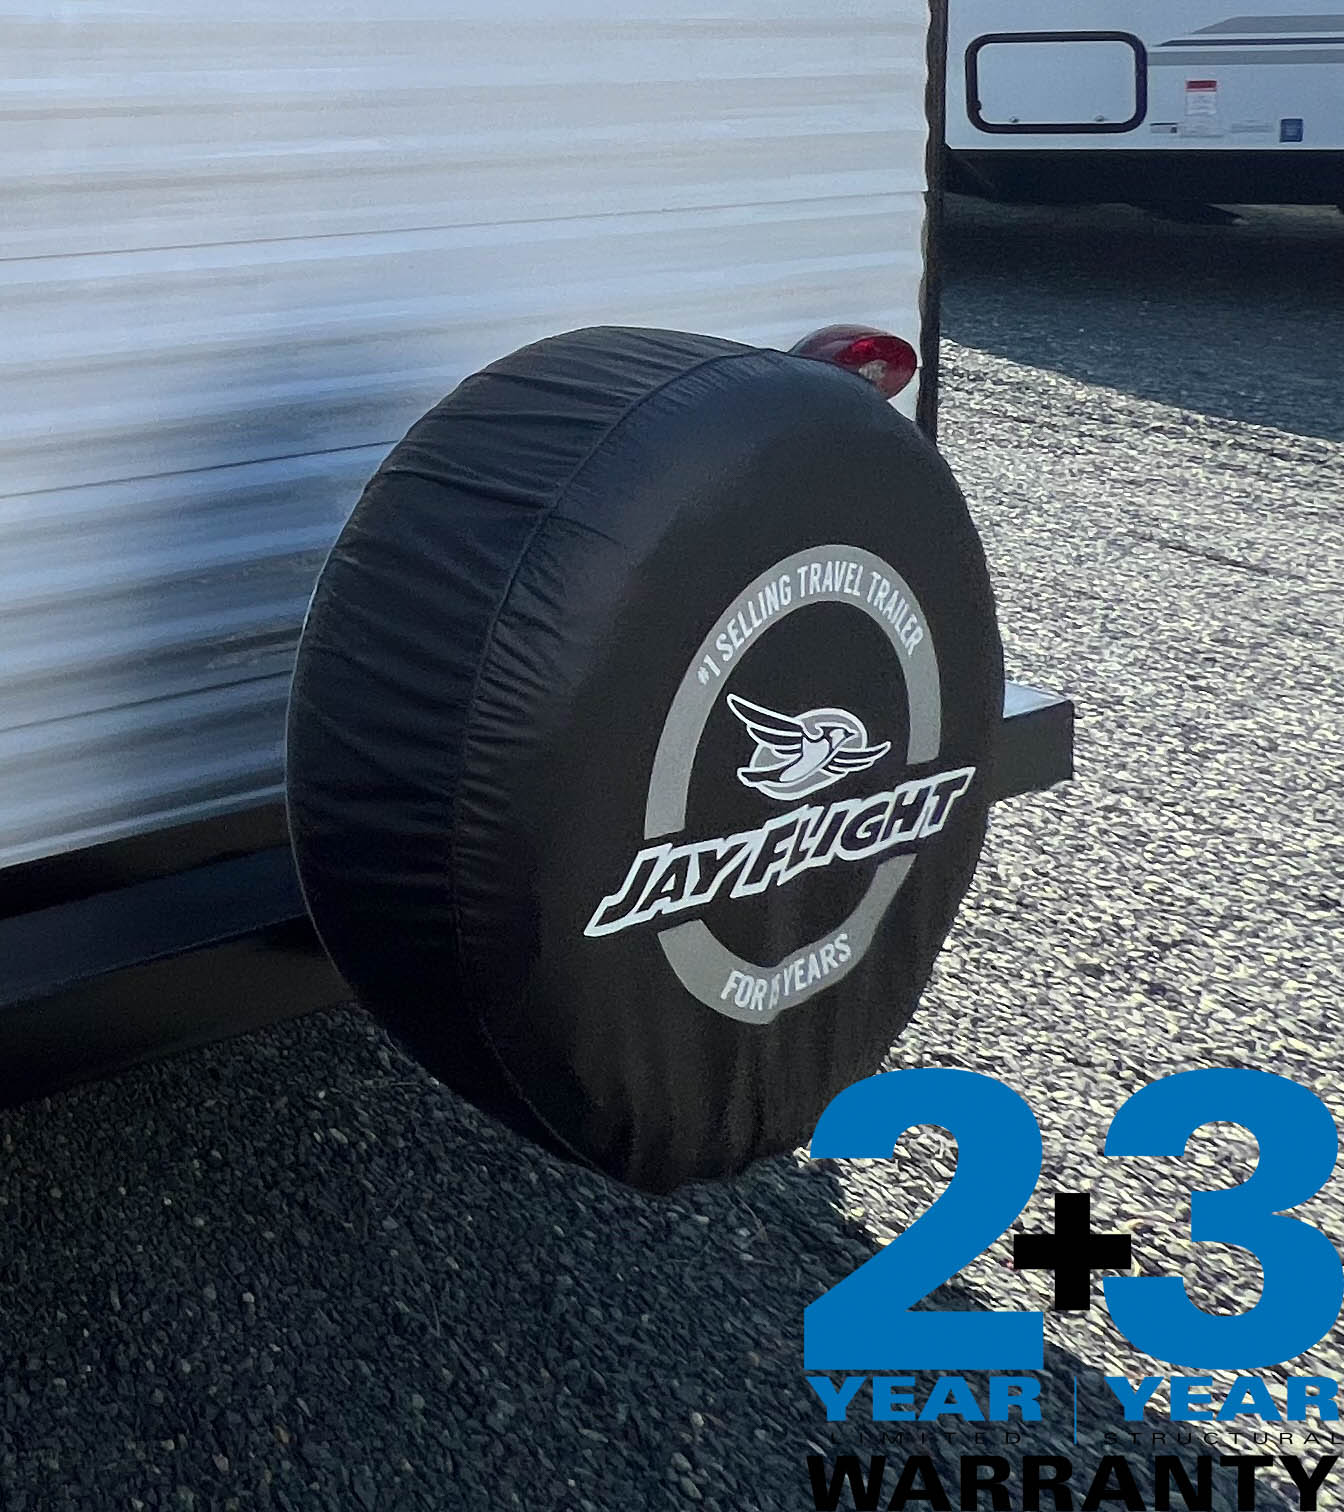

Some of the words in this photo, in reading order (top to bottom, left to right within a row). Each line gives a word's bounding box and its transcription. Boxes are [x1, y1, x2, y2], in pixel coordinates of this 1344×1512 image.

[697, 653, 721, 685] #1
[716, 574, 792, 662] SELLING
[797, 560, 863, 598] TRAVEL
[866, 571, 924, 656] TRAILER
[720, 970, 768, 1011] FOR
[783, 933, 852, 997] YEARS
